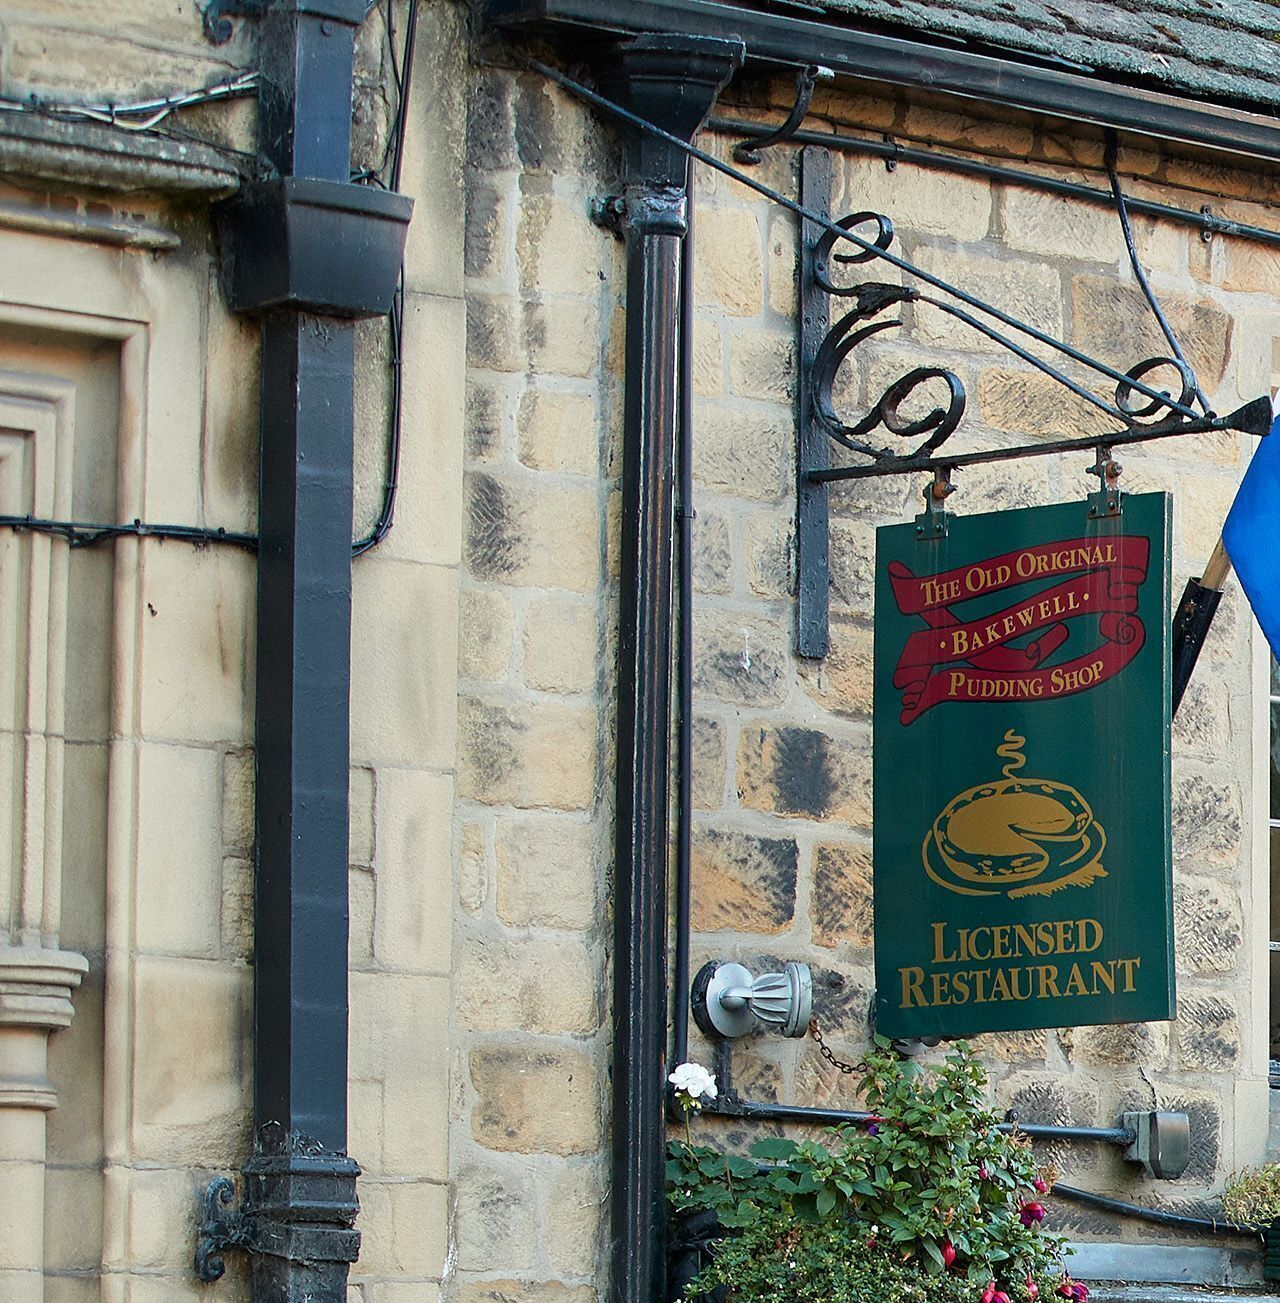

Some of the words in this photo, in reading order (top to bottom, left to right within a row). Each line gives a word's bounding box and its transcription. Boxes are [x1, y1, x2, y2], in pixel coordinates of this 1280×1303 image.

[920, 577, 961, 606] THE
[965, 563, 1011, 594] OLD
[1015, 543, 1118, 577] ORIGINAL
[952, 593, 1080, 656] BAKEWELL
[949, 670, 1045, 698] PUDDING
[1050, 659, 1105, 693] SHOP
[931, 918, 1104, 964] LICENSED
[898, 957, 1141, 1009] RESTAURANT
